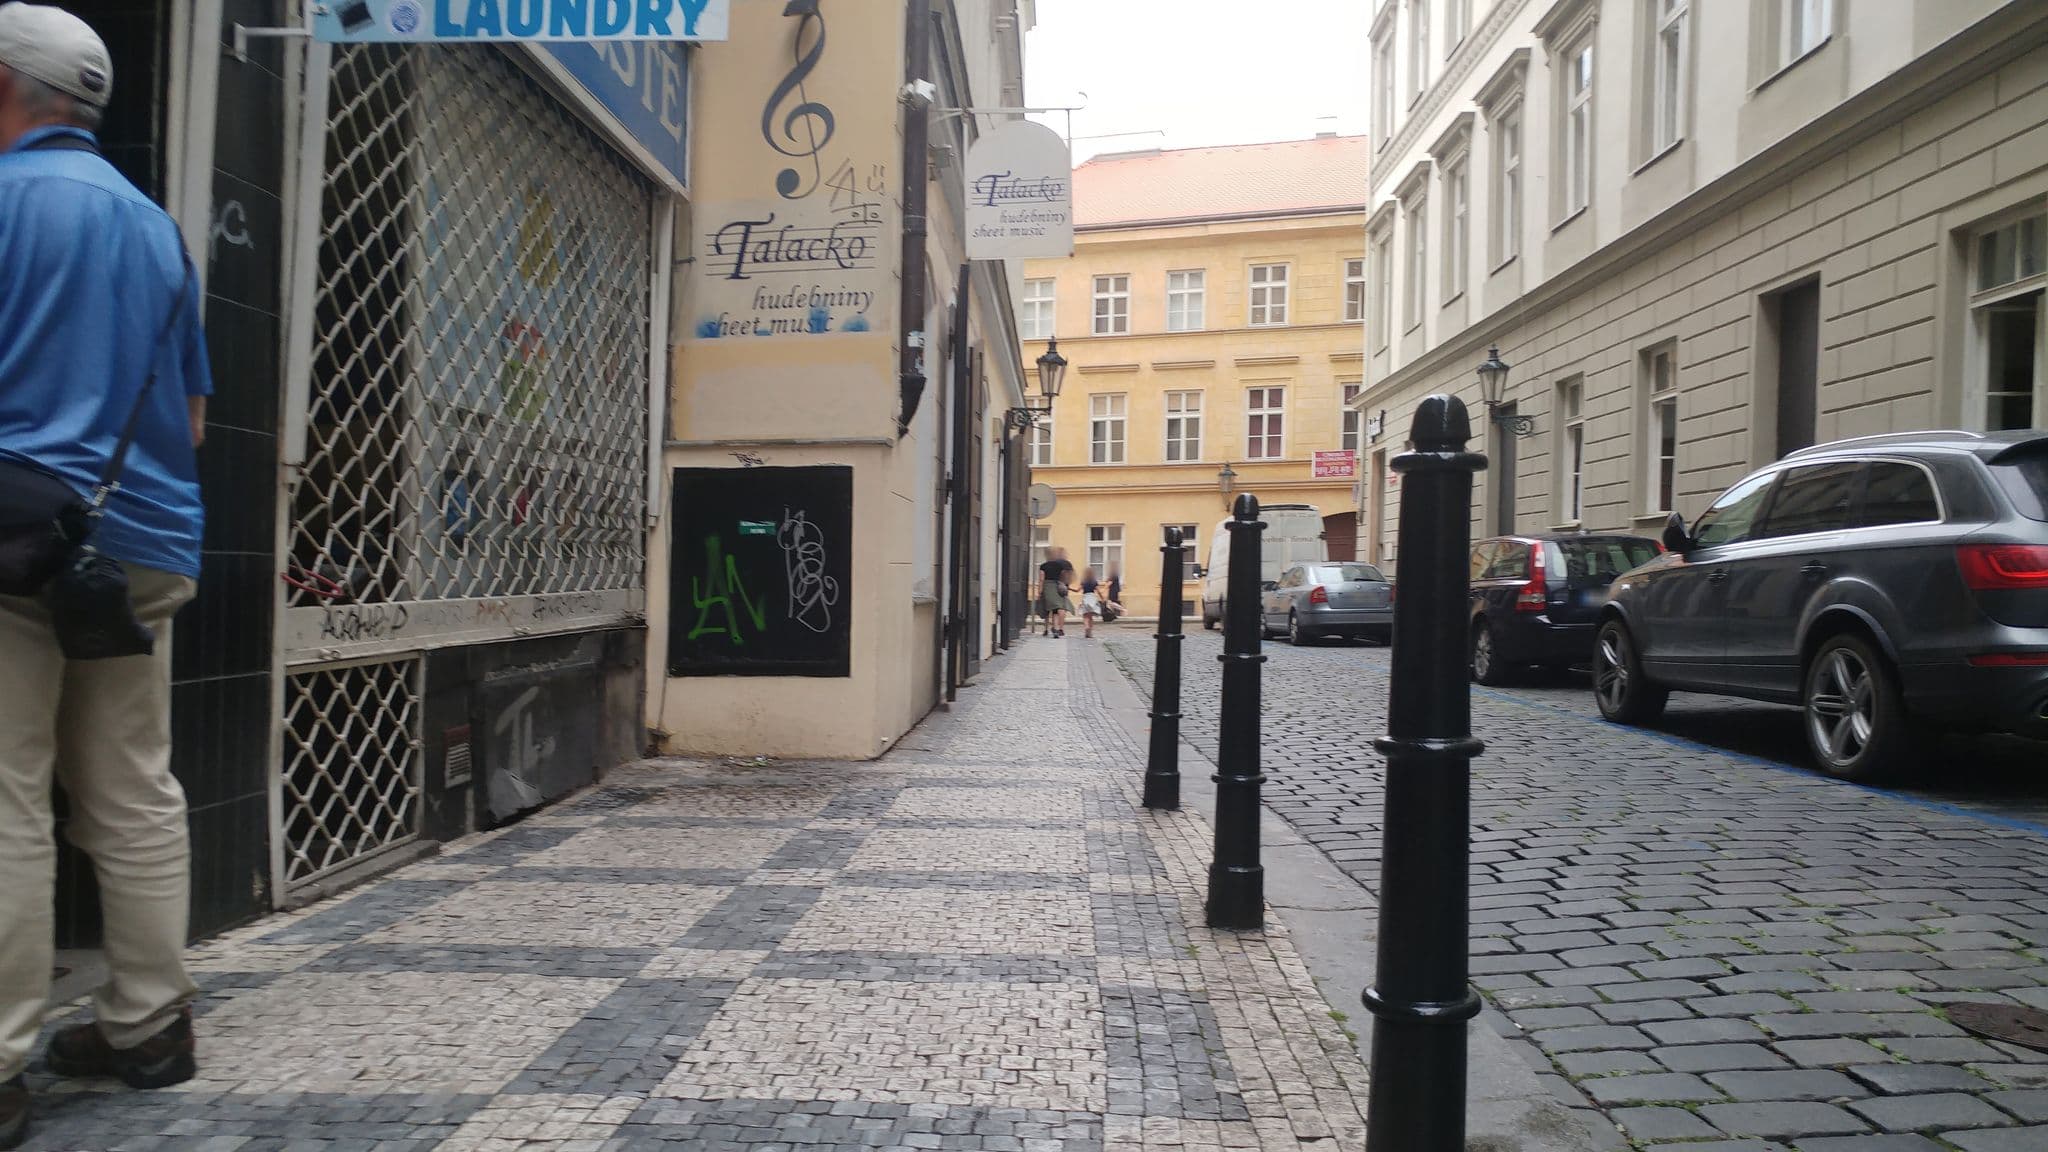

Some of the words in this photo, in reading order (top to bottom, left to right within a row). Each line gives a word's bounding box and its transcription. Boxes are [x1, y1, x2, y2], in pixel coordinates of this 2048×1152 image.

[434, 0, 706, 37] LAUNDRY
[975, 170, 1062, 207] Talacko
[972, 224, 1005, 238] sheet
[1010, 223, 1047, 236] music
[1001, 209, 1065, 226] hudebniny
[715, 212, 866, 279] Talacko
[752, 285, 874, 314] hudebniny
[769, 310, 834, 334] musc
